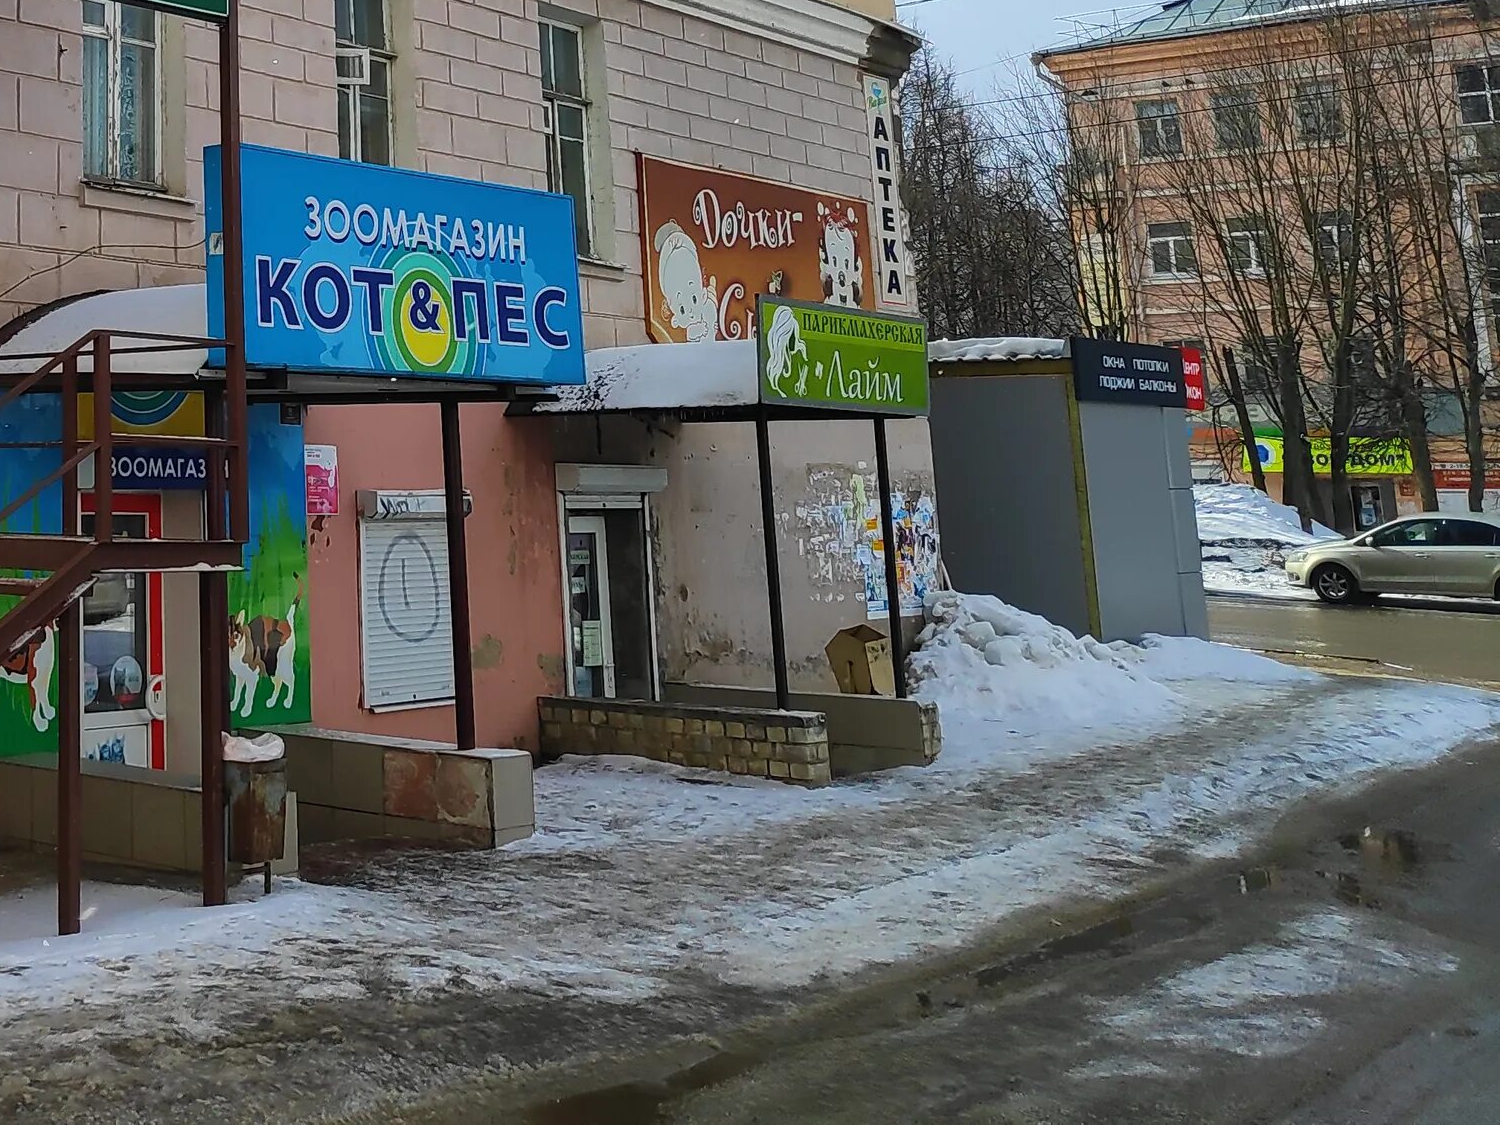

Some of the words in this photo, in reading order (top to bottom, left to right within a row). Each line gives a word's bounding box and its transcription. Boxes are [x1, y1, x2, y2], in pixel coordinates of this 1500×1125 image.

[873, 116, 902, 296] АПТЕКА
[304, 195, 527, 265] ЗООМАГАЗИН
[255, 254, 396, 336] КОТ
[449, 277, 571, 350] ПЕС
[802, 311, 924, 346] ПАРИКМАХЕРСКАЯ
[1102, 355, 1126, 369] ОКНА
[1138, 378, 1178, 393] БАЛКОНЫ
[110, 456, 229, 479] ЗООМАГАЗ
